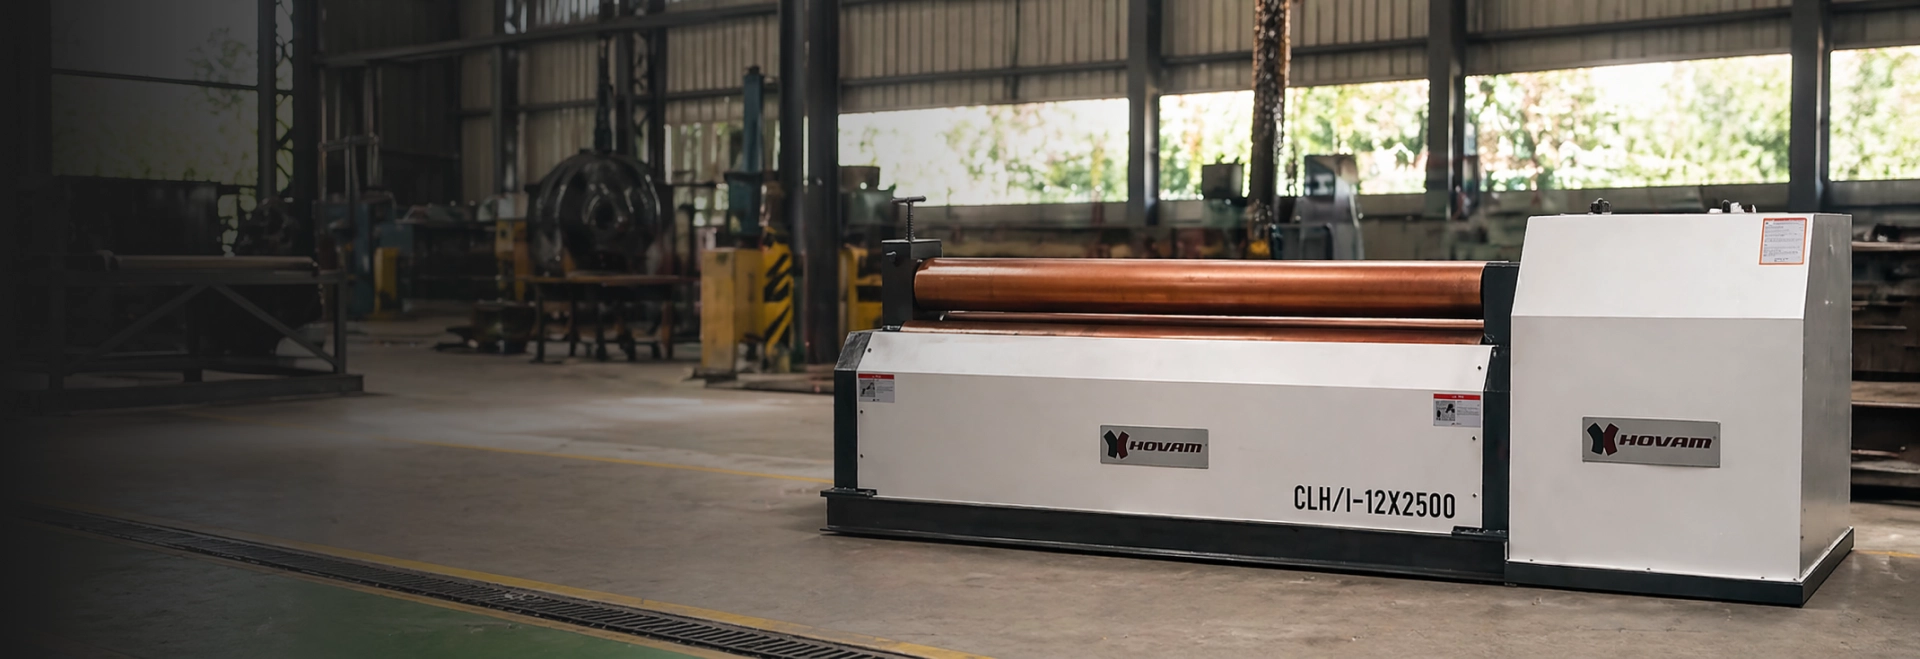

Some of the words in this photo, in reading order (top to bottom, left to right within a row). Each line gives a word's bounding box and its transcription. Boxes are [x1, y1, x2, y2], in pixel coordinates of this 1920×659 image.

[1129, 441, 1202, 453] HOVAM
[1619, 434, 1712, 449] HOVAM
[1294, 485, 1456, 519] CLH/I-12X2500
